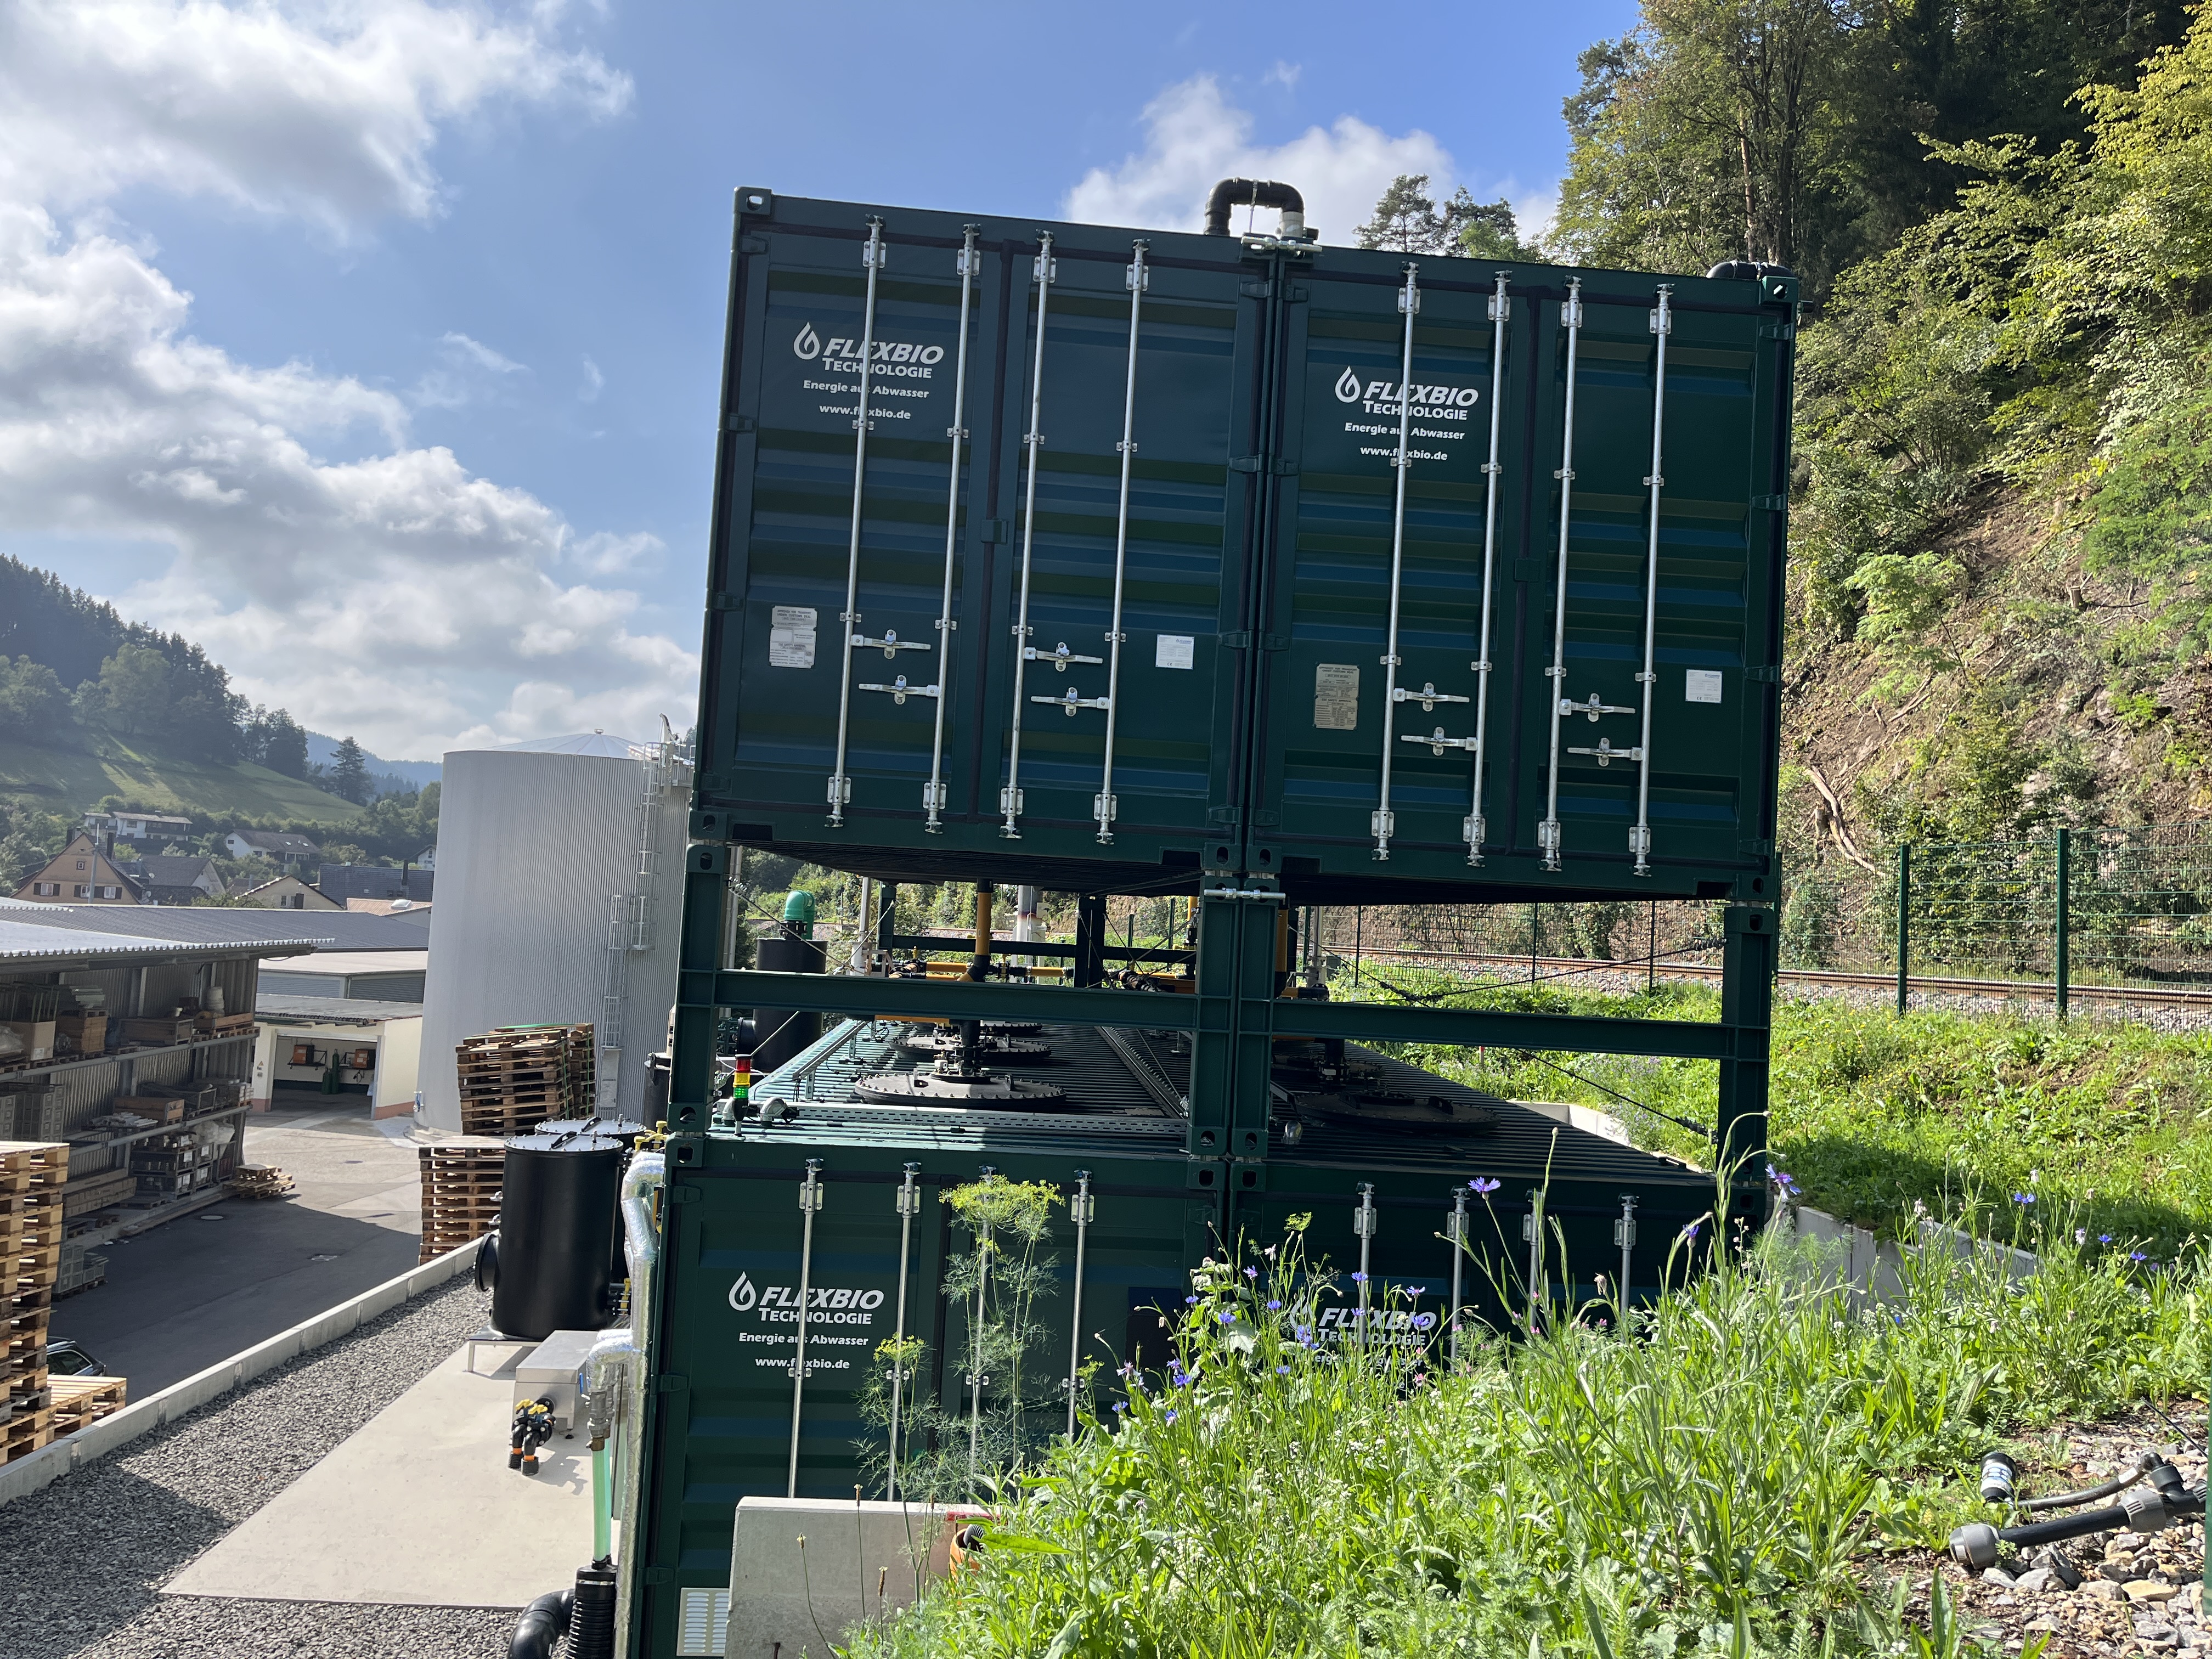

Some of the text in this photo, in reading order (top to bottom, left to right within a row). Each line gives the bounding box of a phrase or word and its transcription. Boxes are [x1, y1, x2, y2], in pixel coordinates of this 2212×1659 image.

[823, 338, 944, 365] FLEXBIO
[803, 380, 929, 398] Energie au Abwasser
[1363, 381, 1479, 407] FLEXBIO
[819, 405, 911, 420] www.flxbio.de
[1345, 422, 1465, 439] Energie au Abwasser
[1360, 446, 1448, 460] www.flxbio.de
[759, 1286, 884, 1310] FLEXBIO
[758, 1307, 872, 1324] TECHNOLOGIE
[739, 1333, 785, 1345] Energie
[810, 1335, 868, 1345] Abwasser
[755, 1358, 850, 1369] www.fxbio.de
